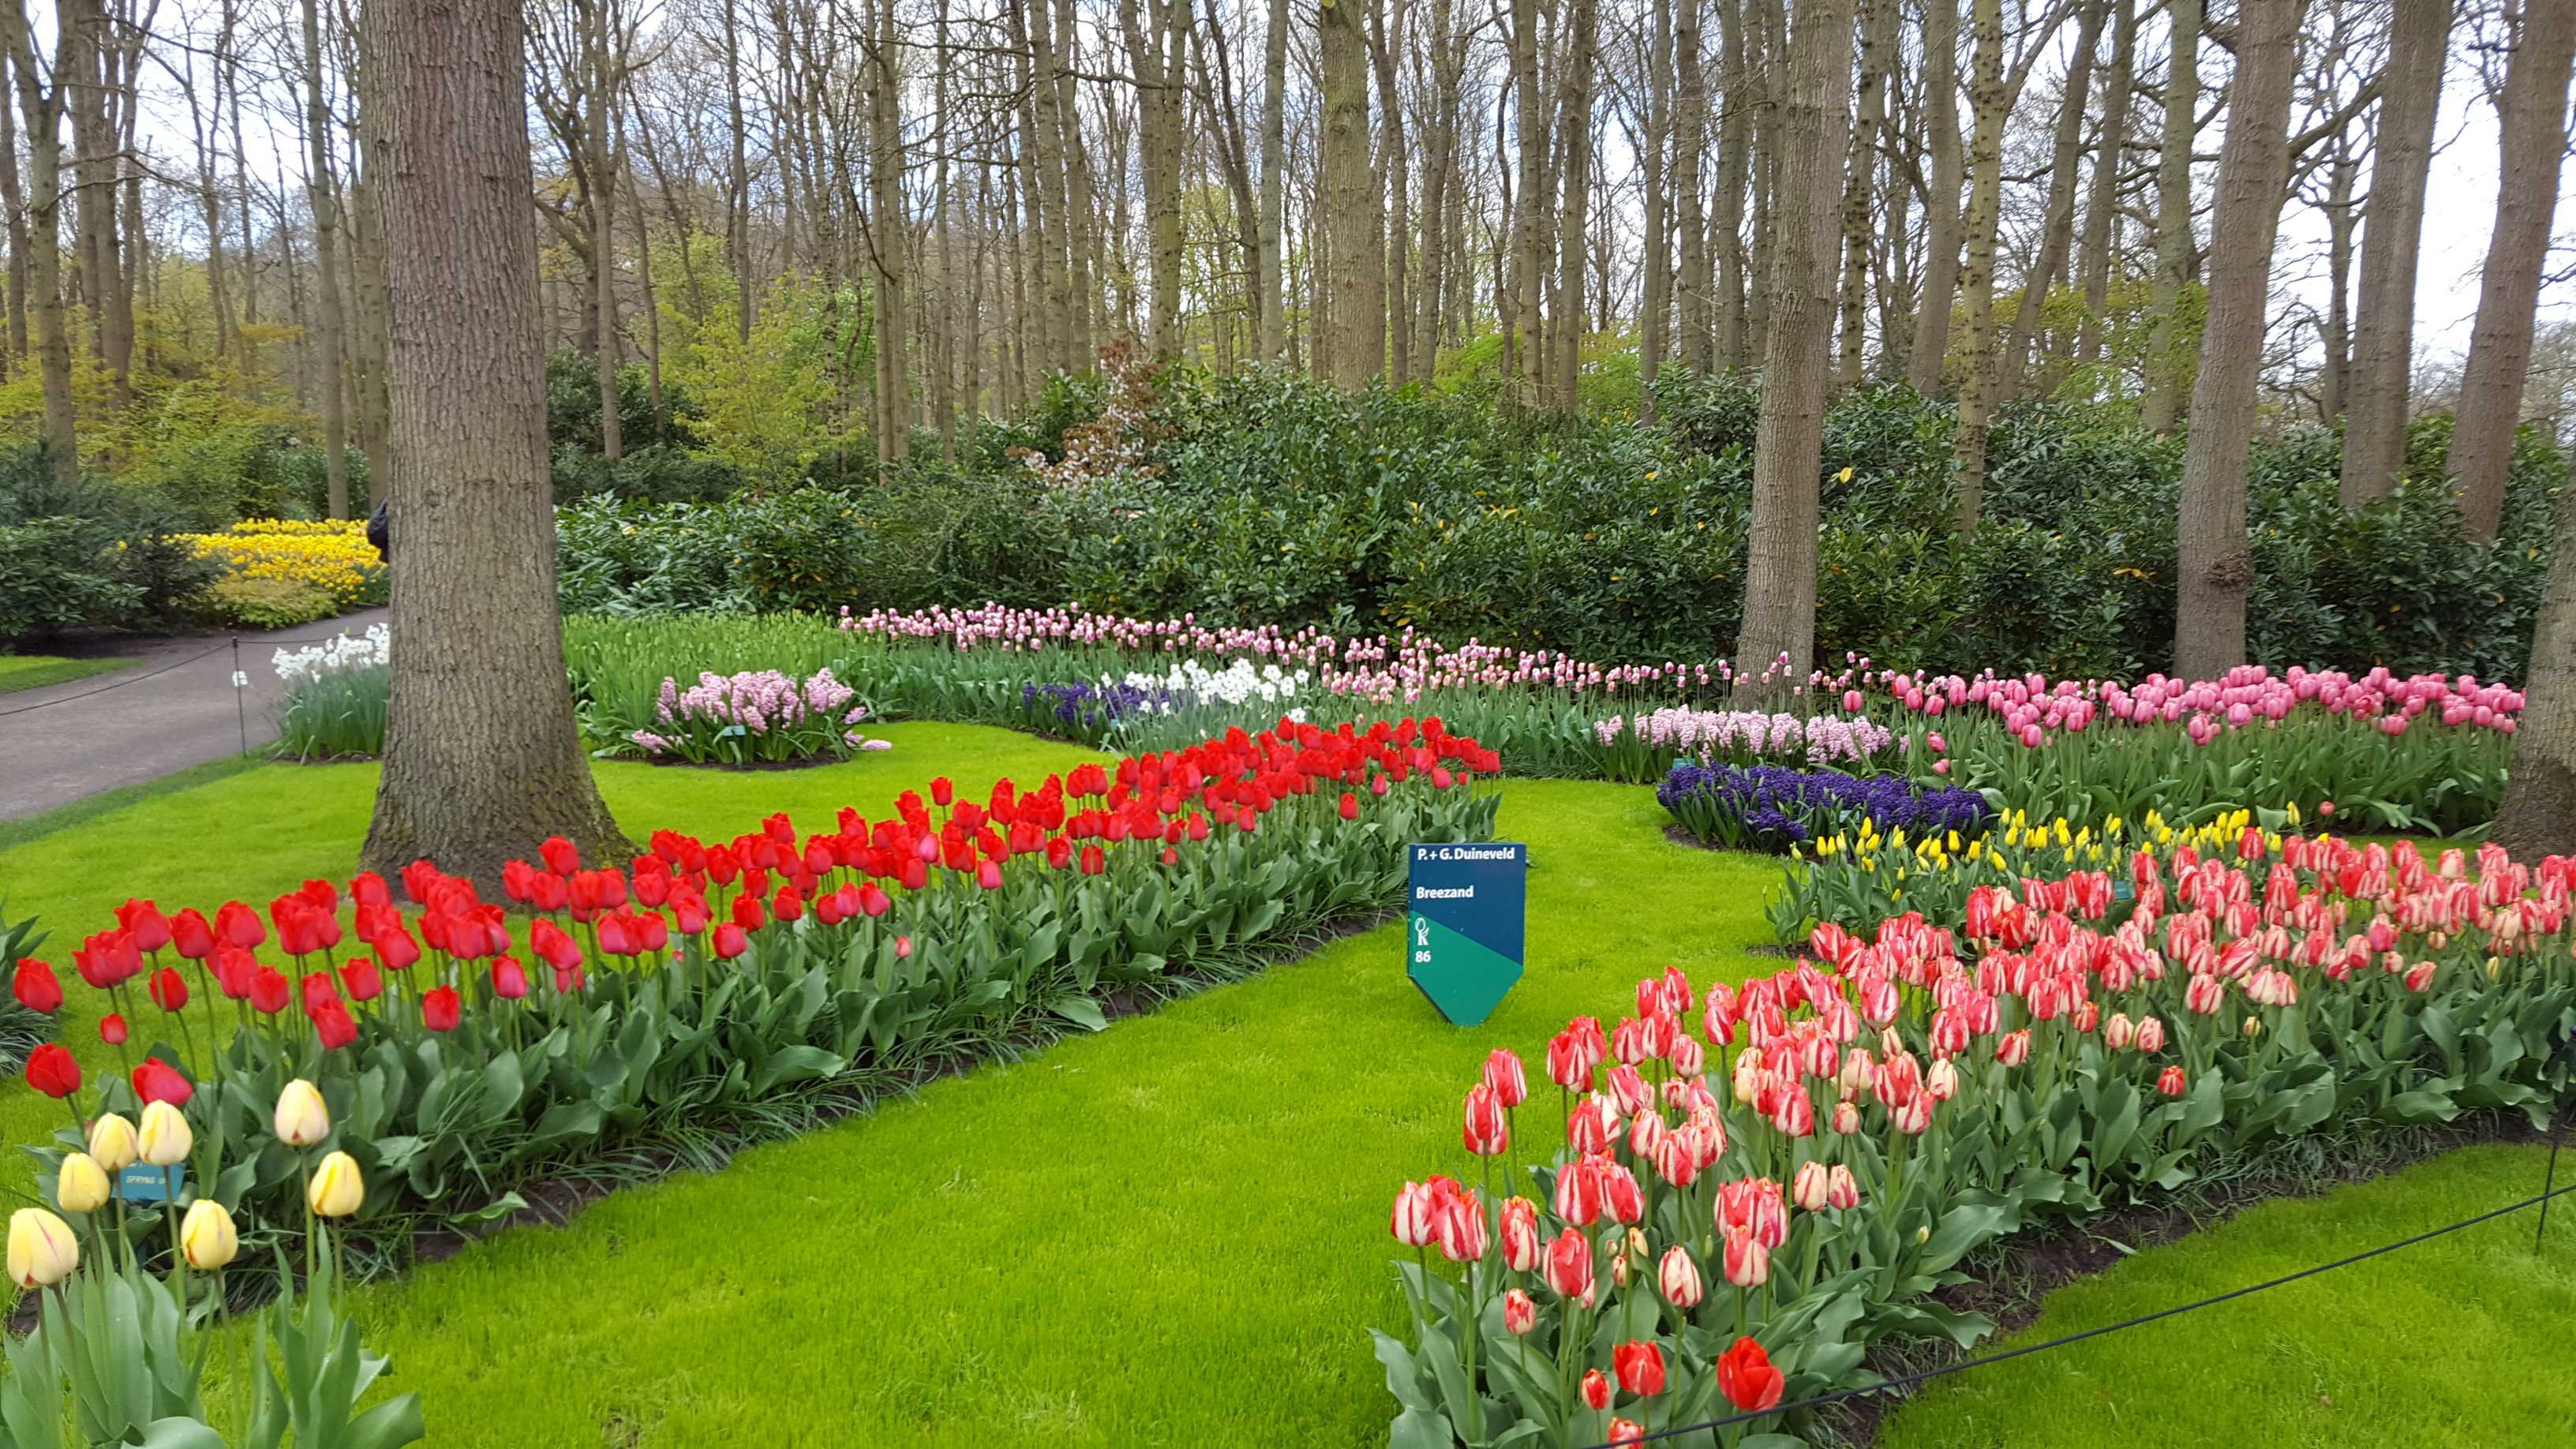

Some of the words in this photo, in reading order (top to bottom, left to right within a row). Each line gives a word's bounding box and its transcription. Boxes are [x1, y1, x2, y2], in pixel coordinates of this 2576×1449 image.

[1417, 848, 1428, 860] P.
[1428, 850, 1437, 860] +
[1439, 848, 1453, 860] G.
[1455, 847, 1515, 860] Duineveld
[1416, 885, 1474, 899] Breezand
[1415, 950, 1431, 963] 86
